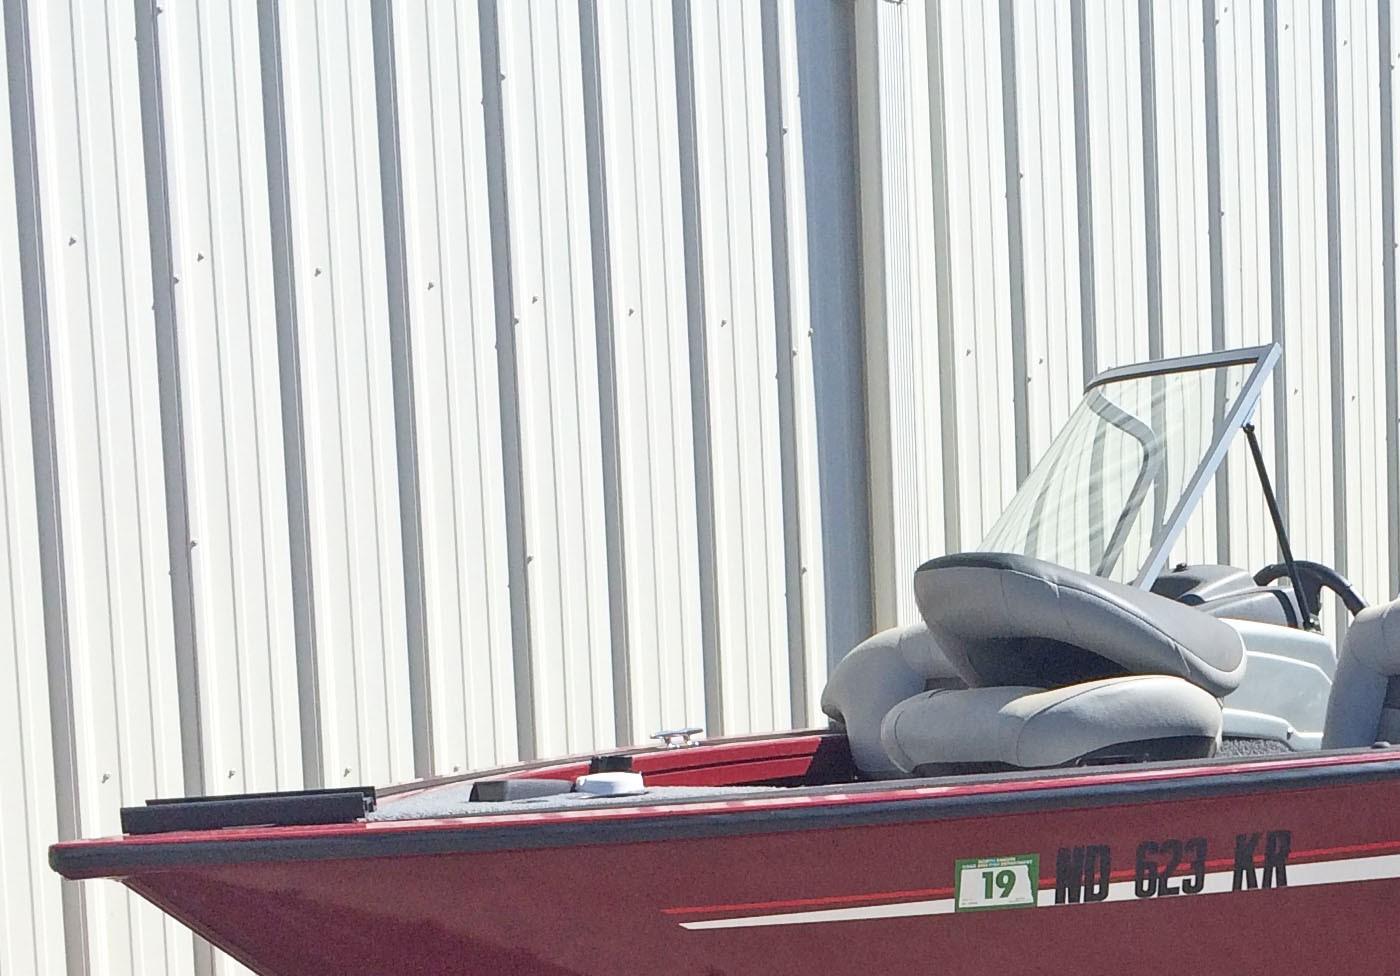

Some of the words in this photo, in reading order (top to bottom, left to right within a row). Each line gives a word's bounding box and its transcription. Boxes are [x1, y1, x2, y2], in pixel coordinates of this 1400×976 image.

[982, 869, 1016, 900] 19
[1055, 844, 1111, 904] ND
[1135, 837, 1208, 898] 623
[1232, 830, 1292, 892] KR
